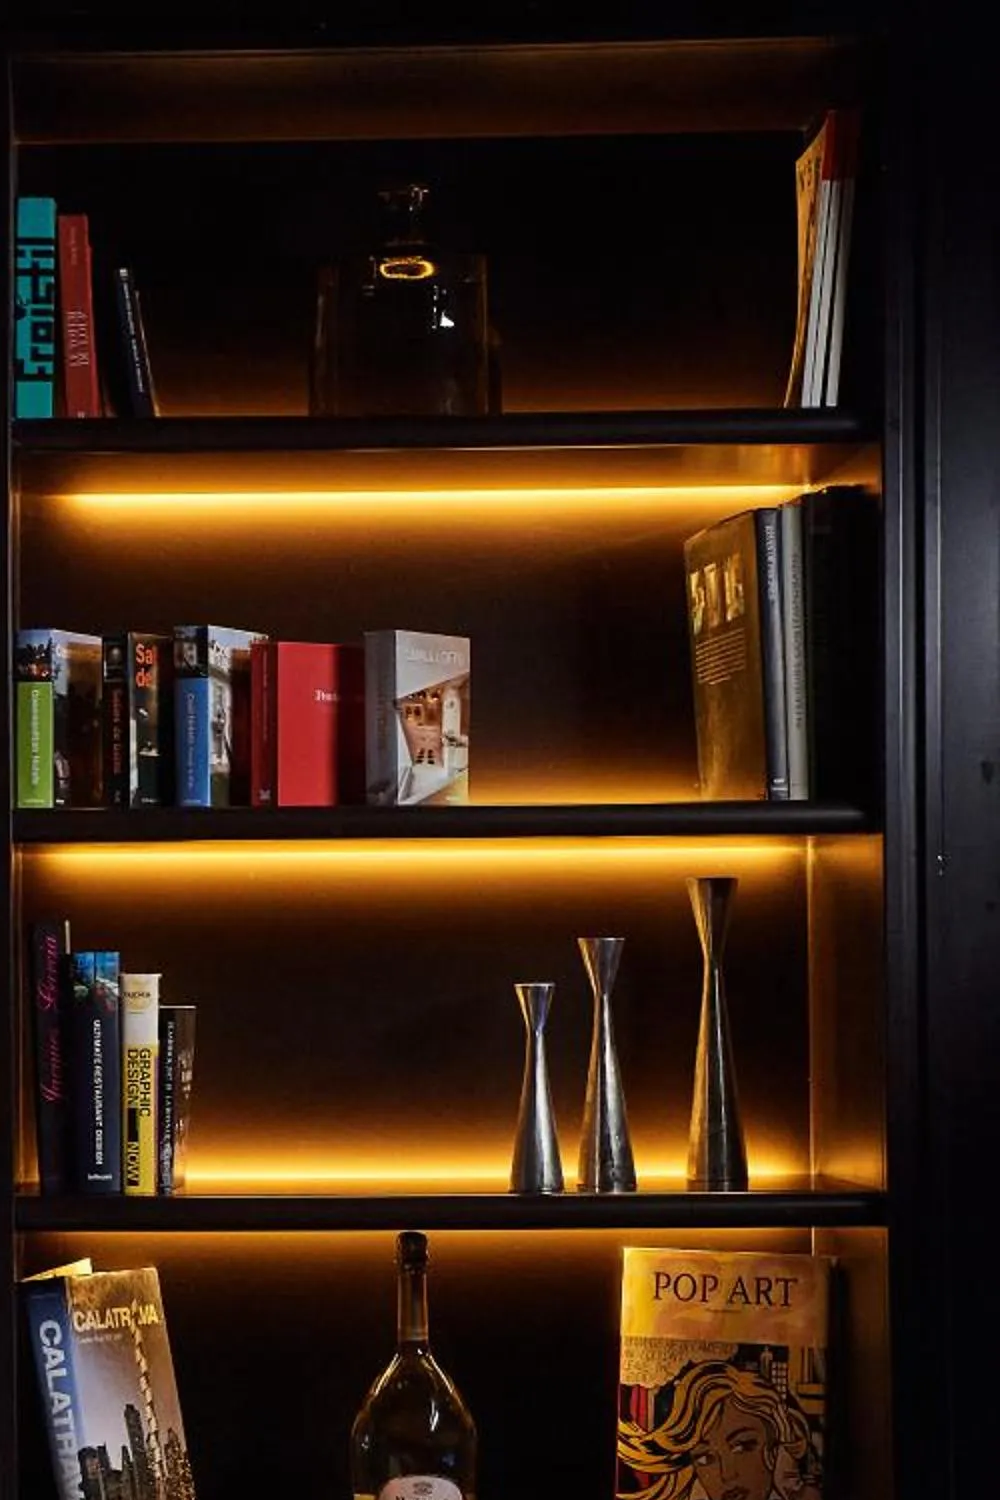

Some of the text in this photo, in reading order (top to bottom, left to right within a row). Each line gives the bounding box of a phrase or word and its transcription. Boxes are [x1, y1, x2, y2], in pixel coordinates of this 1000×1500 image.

[92, 1018, 103, 1065] ULTIMATE
[127, 1048, 139, 1109] DESIGN
[139, 1047, 151, 1118] GRAPHIC
[652, 1271, 799, 1308] POP ART
